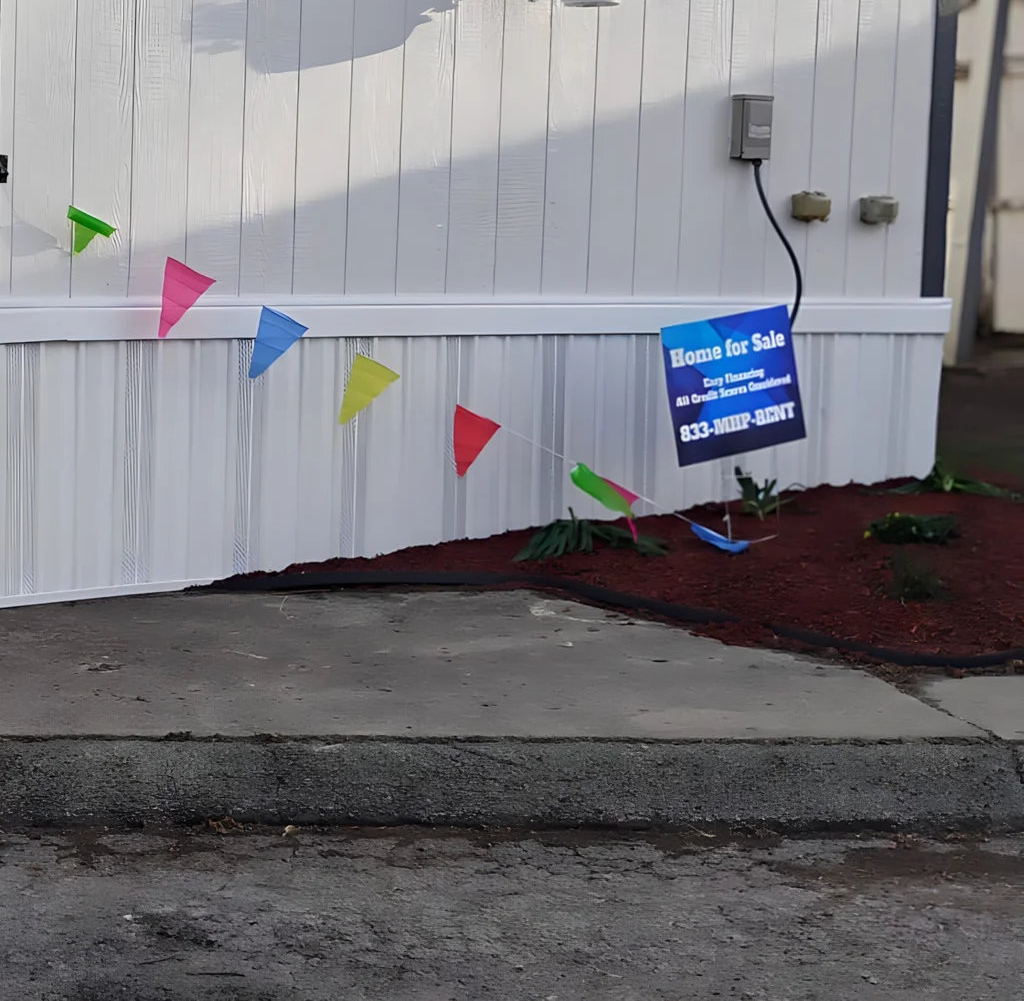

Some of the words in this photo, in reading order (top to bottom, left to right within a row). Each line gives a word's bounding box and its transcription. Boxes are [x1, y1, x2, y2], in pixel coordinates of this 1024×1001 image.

[669, 345, 722, 368] Home
[725, 338, 749, 357] for
[751, 330, 785, 352] Sale
[676, 395, 690, 407] All
[691, 388, 718, 404] Credit
